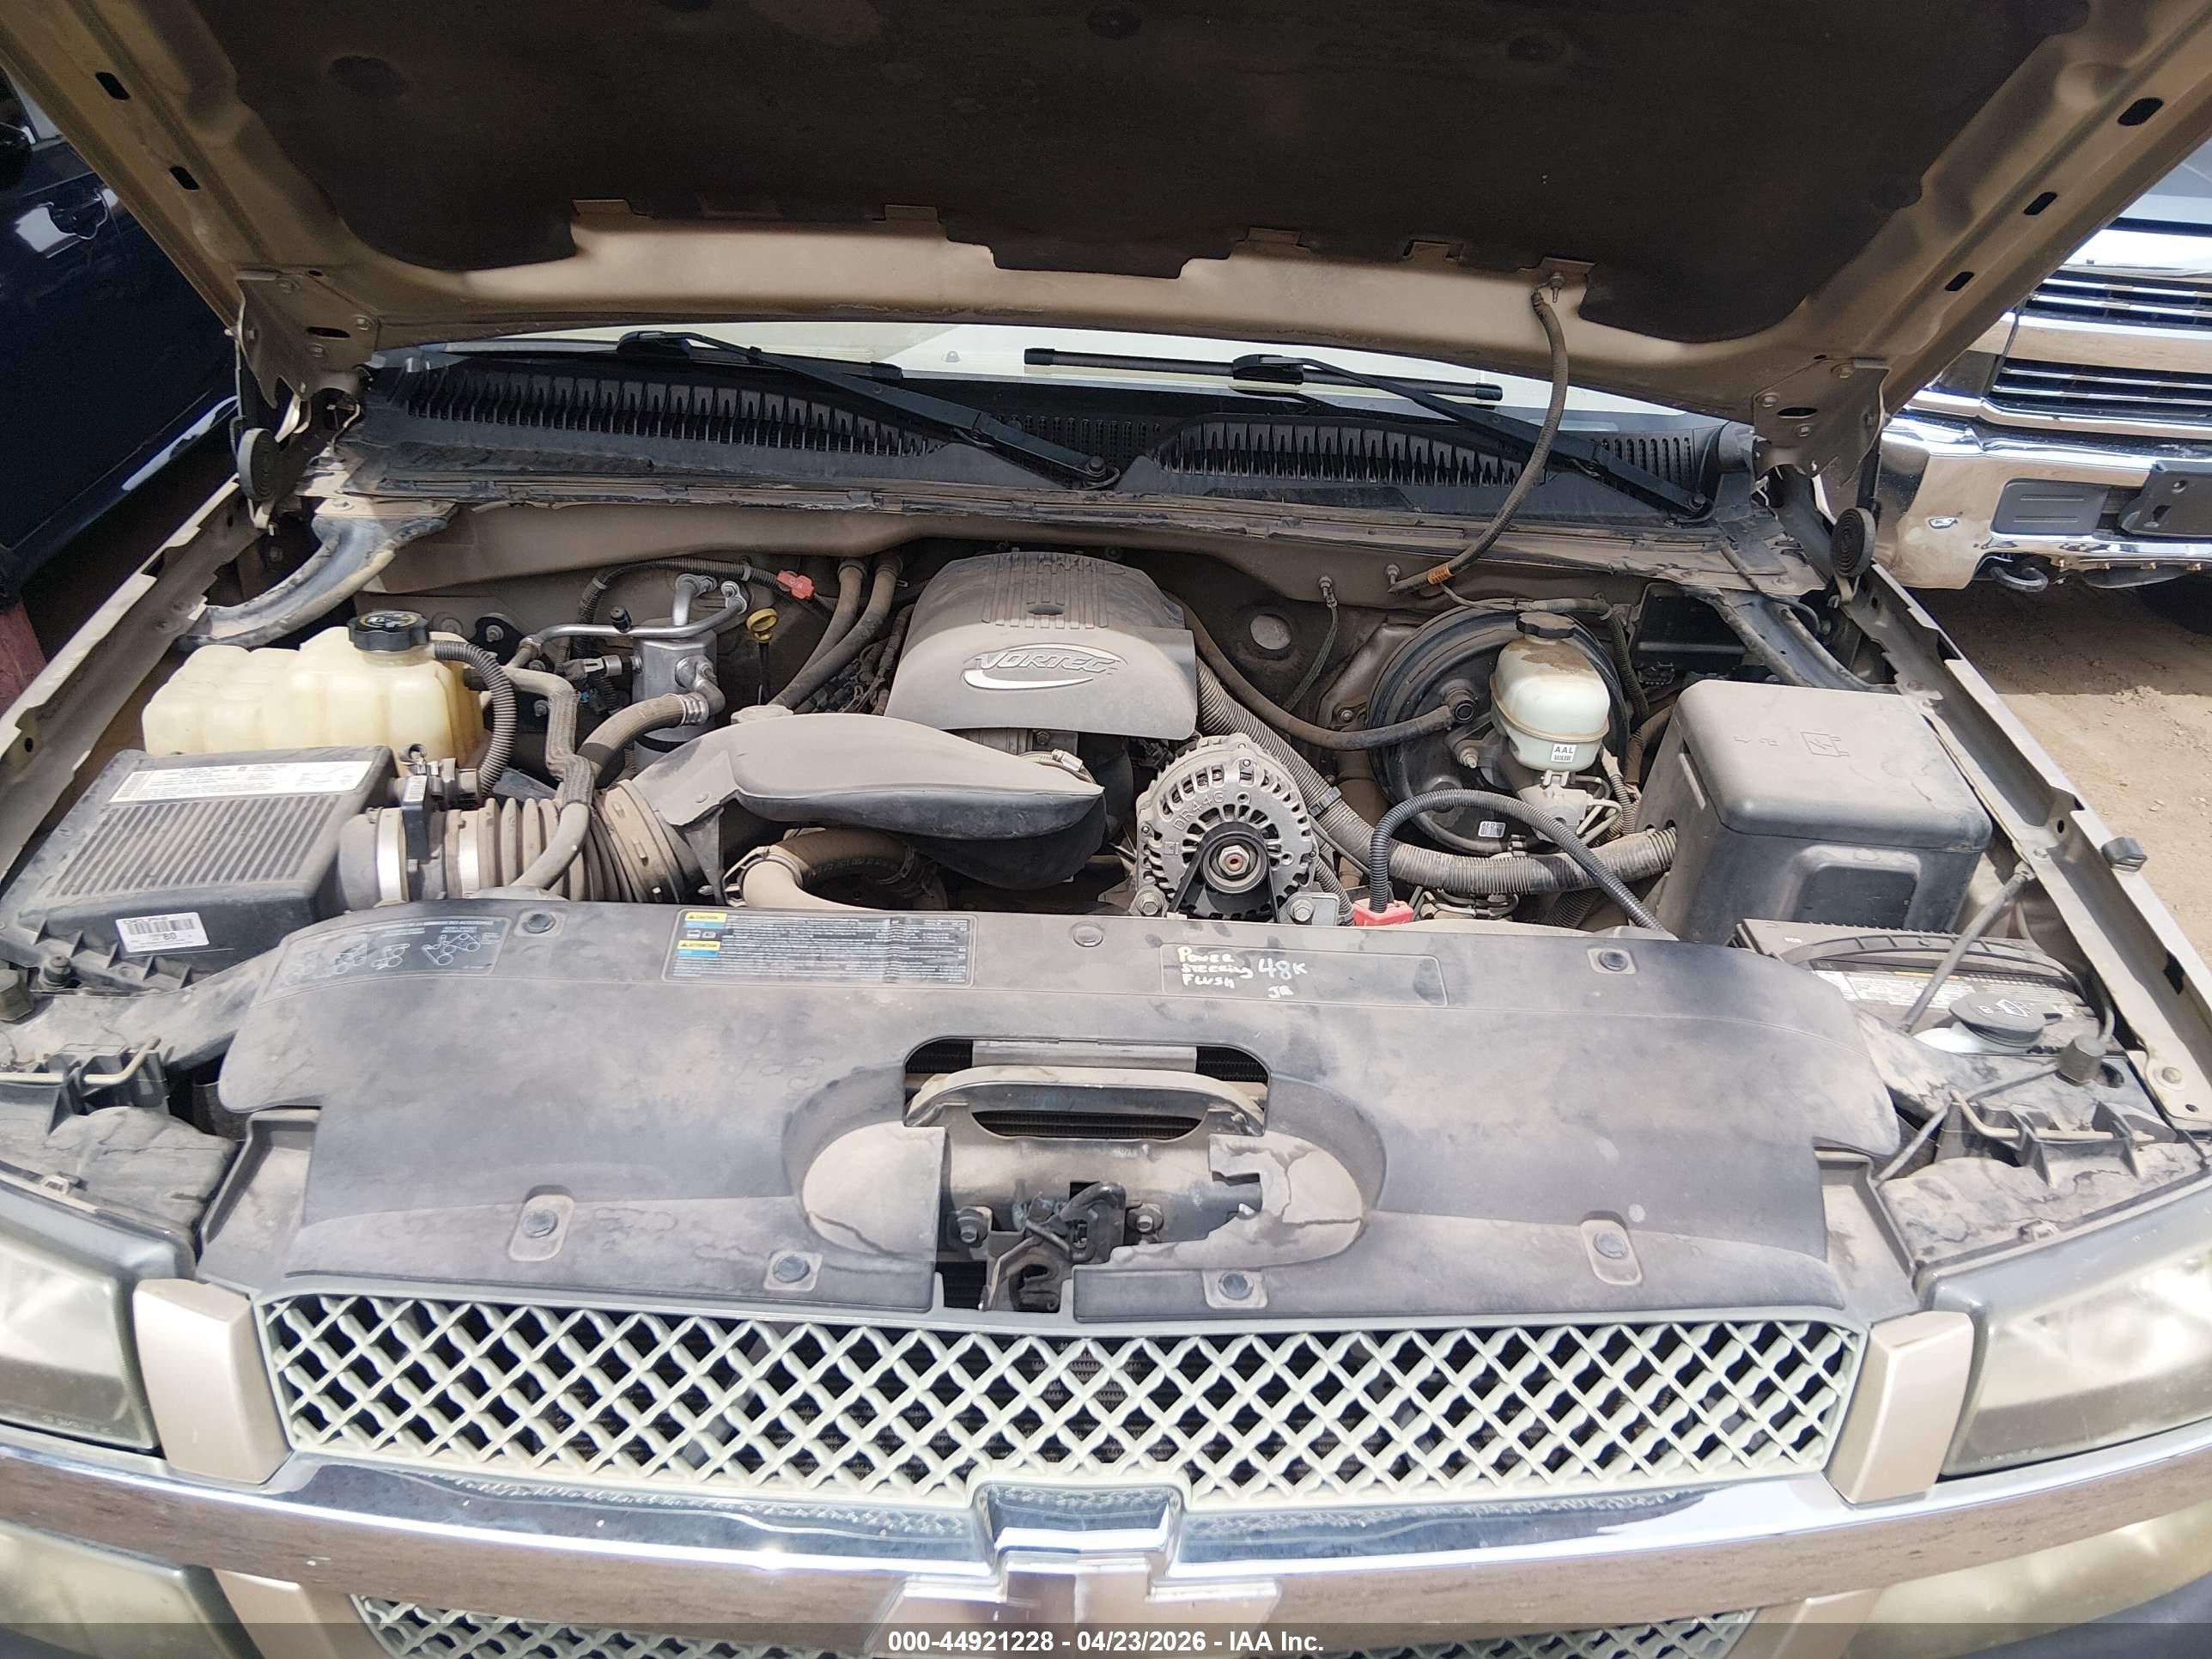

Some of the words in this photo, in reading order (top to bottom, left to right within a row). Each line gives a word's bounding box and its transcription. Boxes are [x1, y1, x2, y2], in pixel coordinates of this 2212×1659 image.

[975, 651, 1116, 674] VORTEC
[1554, 745, 1574, 754] AAL
[1173, 792, 1224, 831] DR44G
